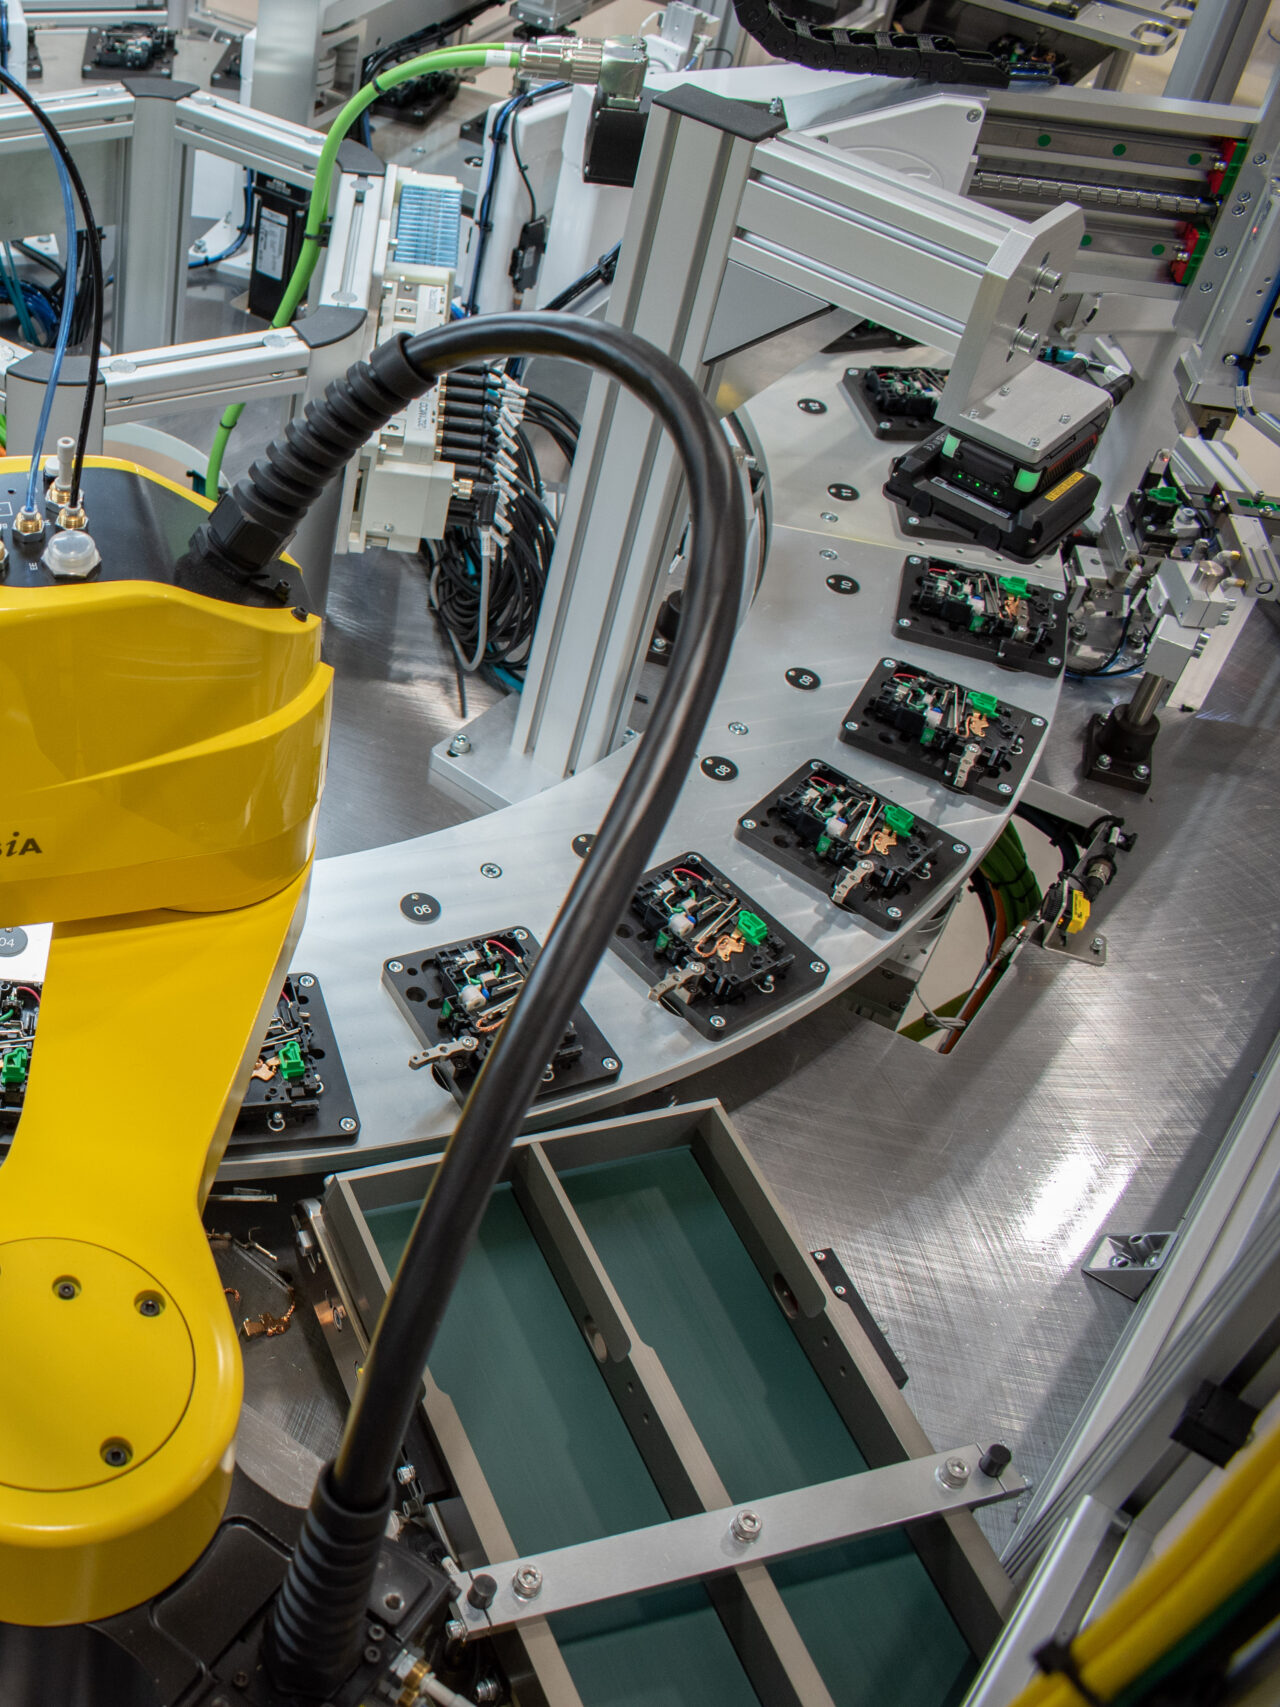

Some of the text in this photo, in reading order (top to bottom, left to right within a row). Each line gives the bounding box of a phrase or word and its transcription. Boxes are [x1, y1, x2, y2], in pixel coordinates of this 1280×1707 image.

[840, 580, 852, 590] 10
[799, 674, 814, 686] 09
[715, 764, 731, 776] 08
[413, 904, 432, 915] 06
